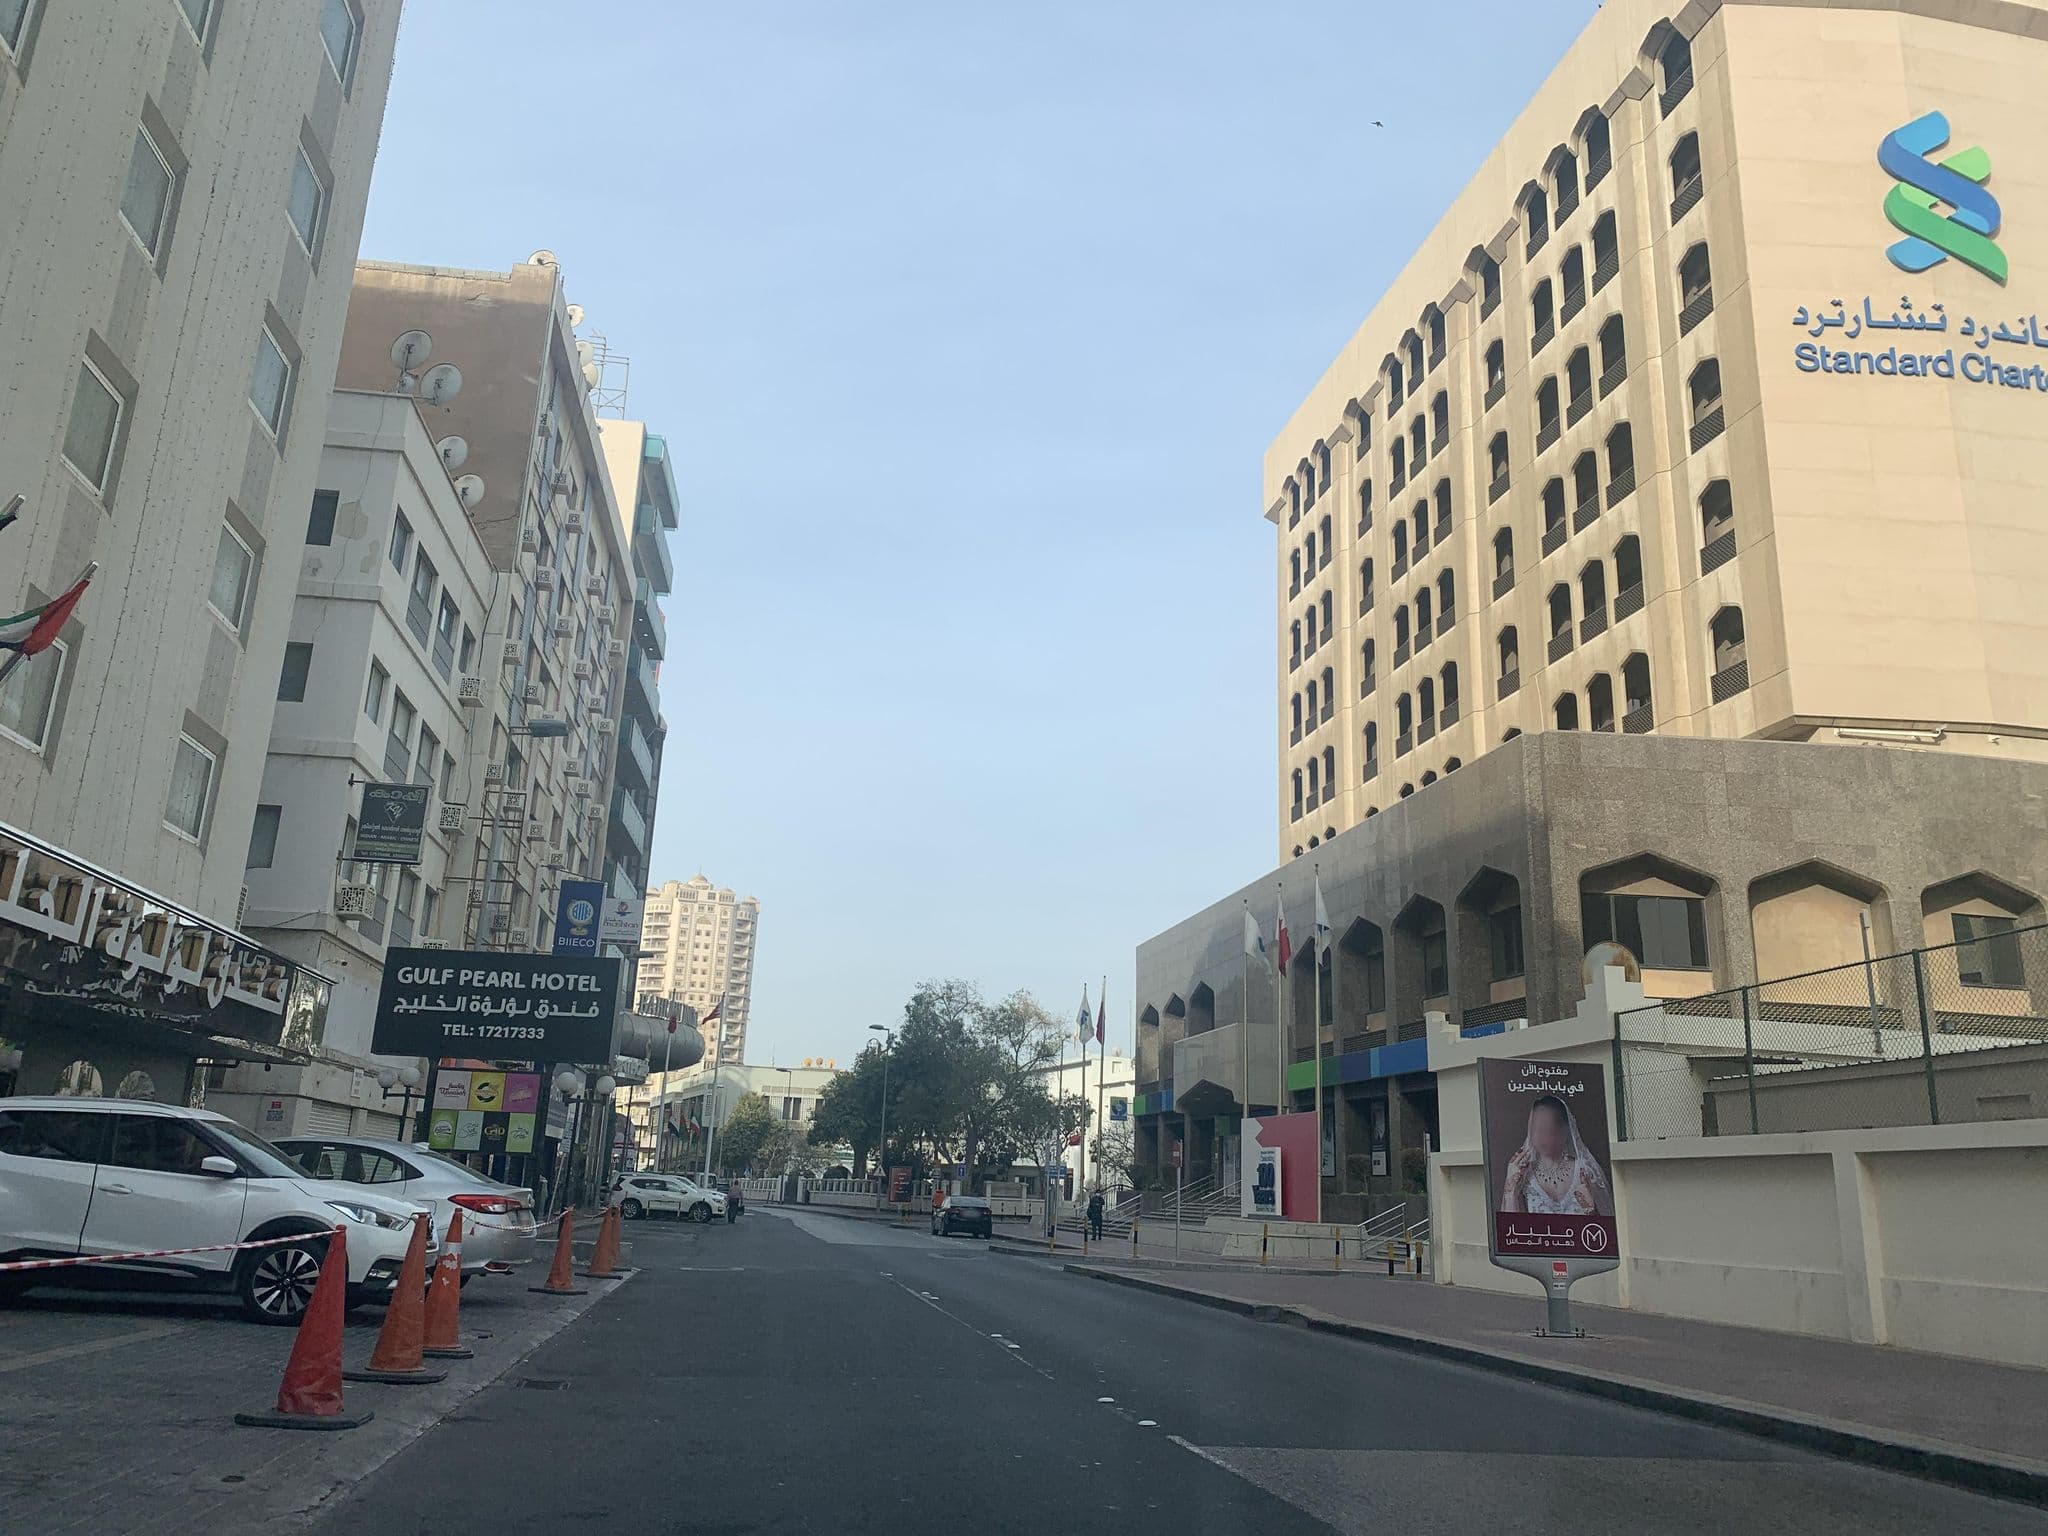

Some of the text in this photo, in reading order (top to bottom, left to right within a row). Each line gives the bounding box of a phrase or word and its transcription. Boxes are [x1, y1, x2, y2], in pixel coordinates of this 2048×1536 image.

[1792, 295, 2048, 350] اندرد تشارترد
[1794, 343, 2048, 392] Standard Chart
[0, 847, 289, 1015] فندق لؤلؤة الخل
[397, 967, 602, 992] GULF PEARL HOTEL
[393, 993, 600, 1019] فندق لؤلؤة الخليج
[442, 1024, 545, 1039] TEL: 17217333
[1521, 1062, 1569, 1078] مفتوح الآن
[1508, 1080, 1584, 1097] في باب البحرين
